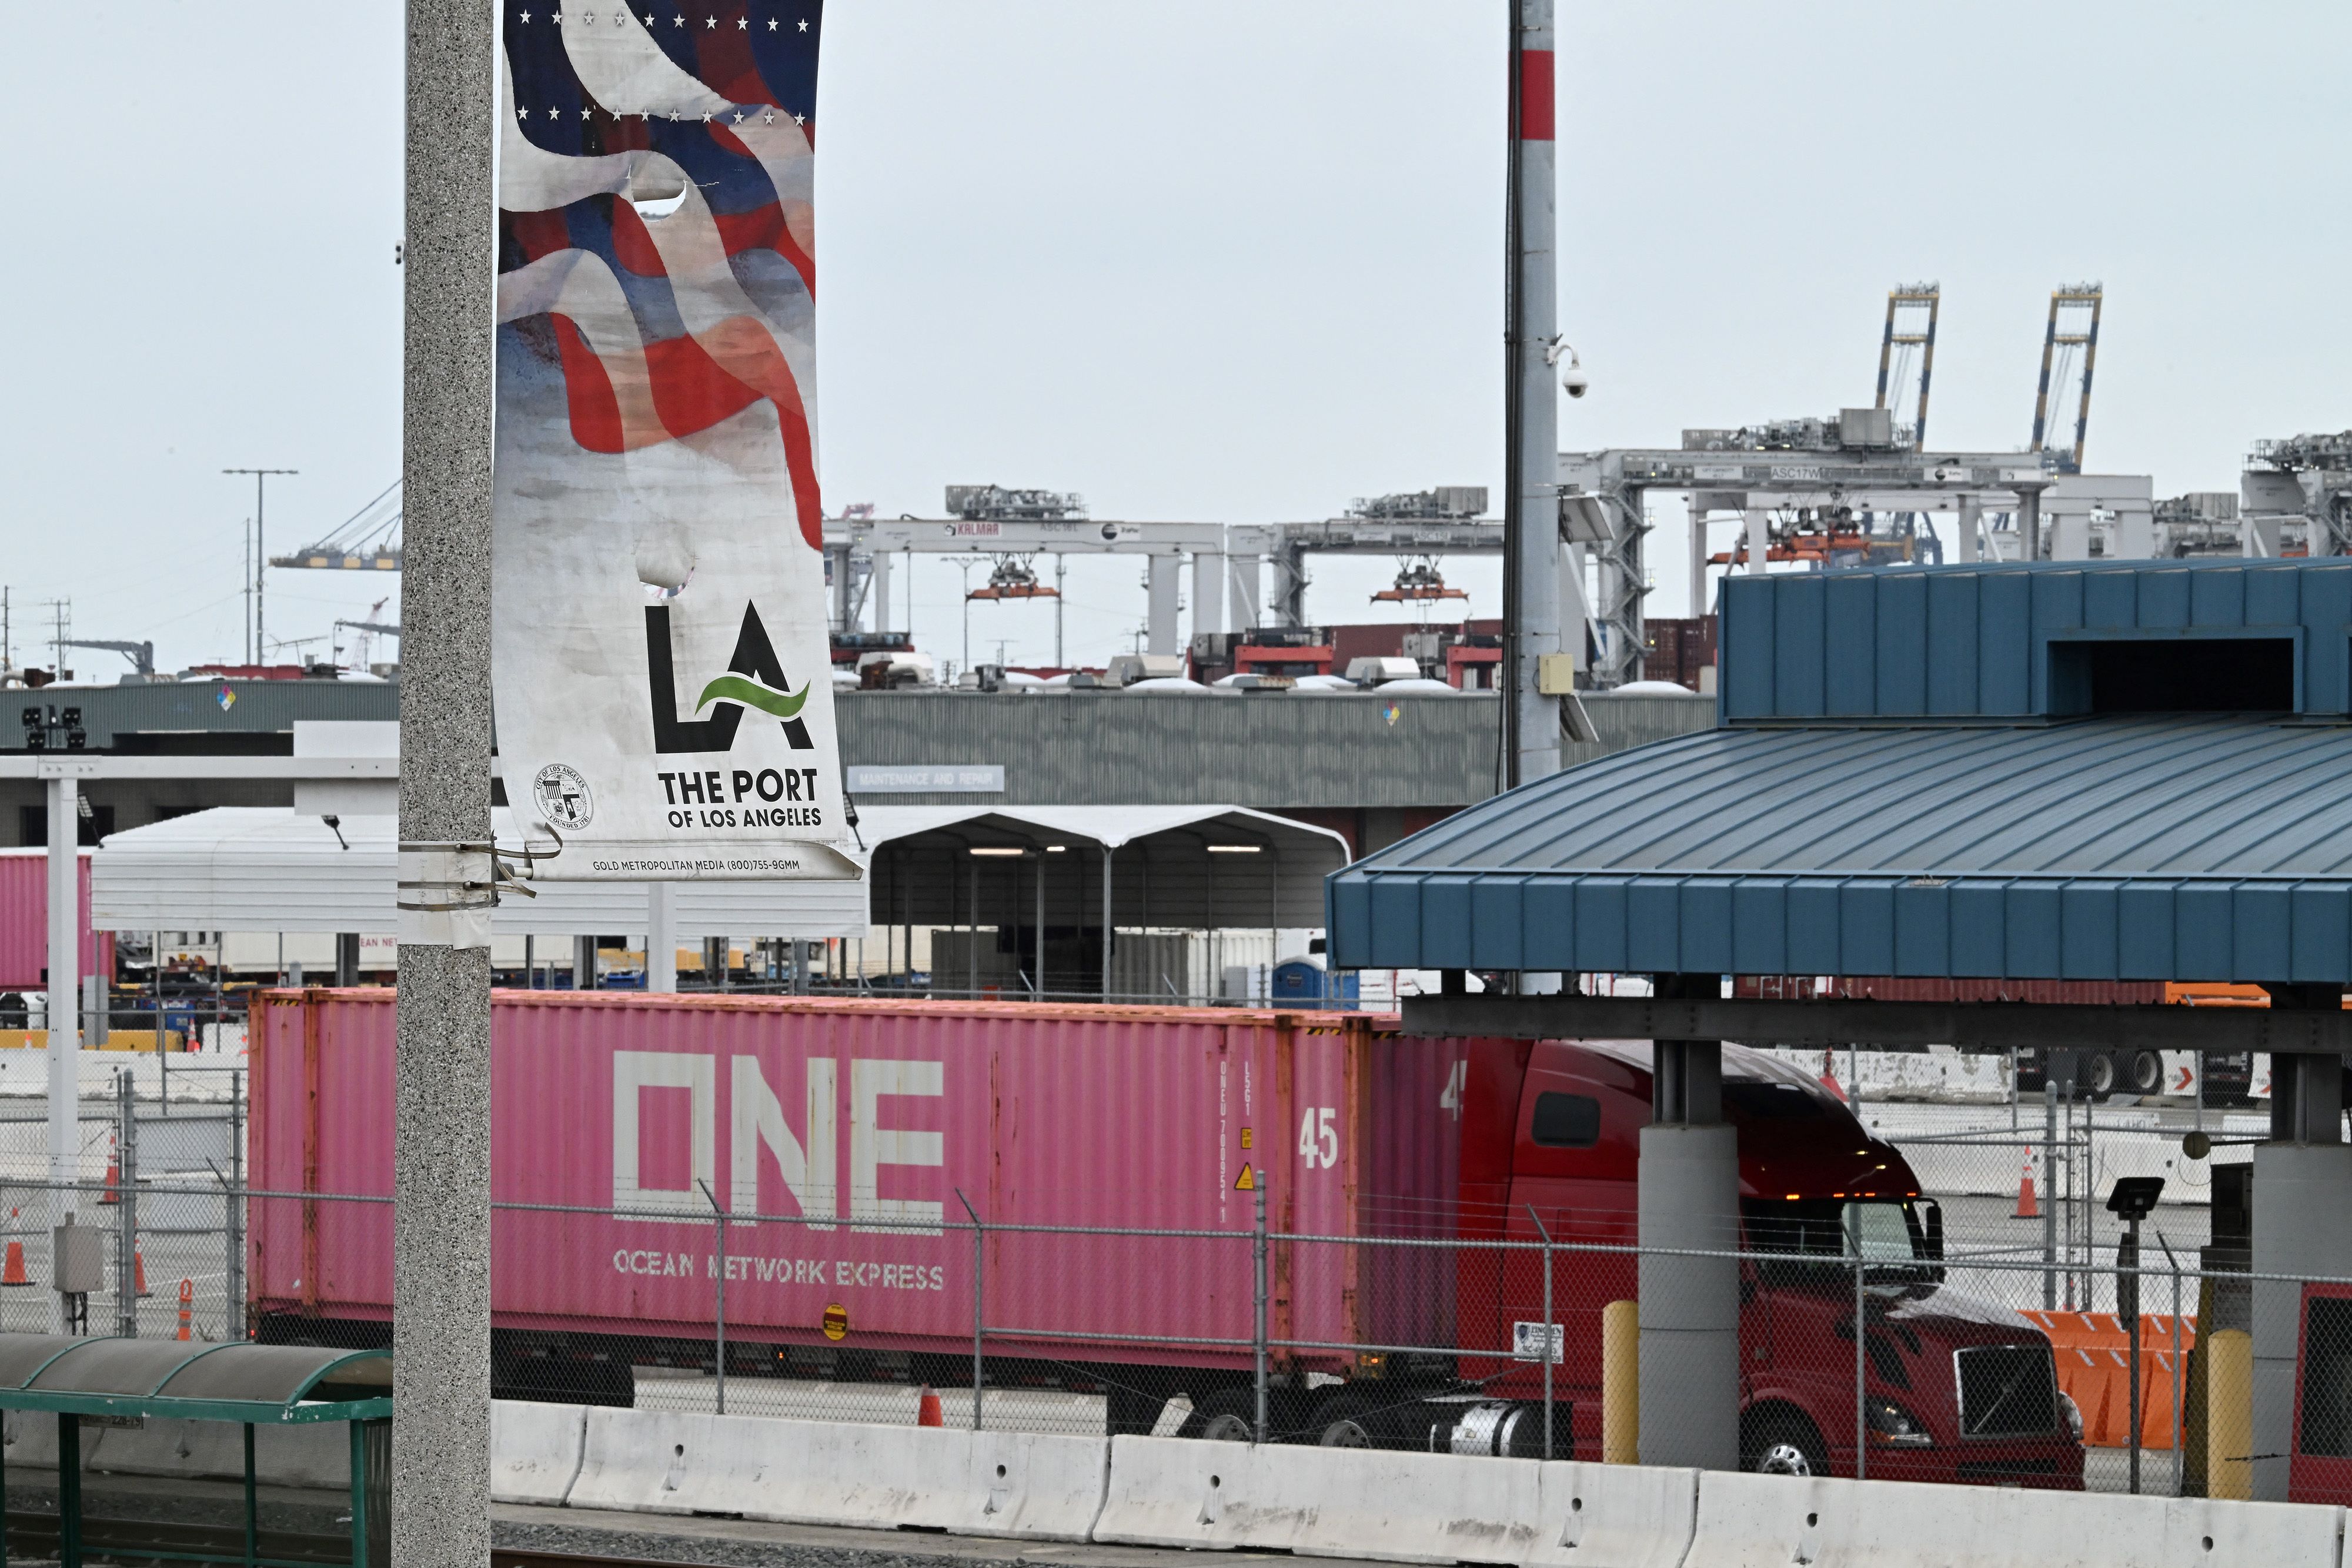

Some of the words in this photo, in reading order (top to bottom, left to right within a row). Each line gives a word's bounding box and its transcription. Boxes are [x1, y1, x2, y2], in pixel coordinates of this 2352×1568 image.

[1772, 467, 1820, 479] ASC17W
[958, 522, 998, 535] KALMAR
[645, 599, 814, 754] LA
[562, 768, 585, 788] ANGELES
[657, 771, 724, 804] THE
[733, 768, 817, 803] PORT
[859, 773, 928, 785] MAINTENANCE
[933, 773, 954, 785] AND
[959, 773, 993, 785] REPAIR
[549, 815, 578, 828] FOUNDED
[579, 815, 590, 826] 1781
[668, 811, 693, 828] OF
[700, 810, 736, 827] LOS
[743, 808, 821, 827] ANGELES
[593, 861, 619, 870] GOLD
[621, 861, 693, 870] METROPOLITAN
[696, 860, 725, 870] MEDIA
[727, 860, 800, 871] (800)755-9GMM
[360, 938, 377, 947] EAN
[613, 1050, 943, 1236] ONE
[1299, 1108, 1338, 1168] 45
[613, 1249, 694, 1277] OCEAN
[707, 1255, 826, 1285] NETWORK
[836, 1261, 943, 1290] EXPRESS
